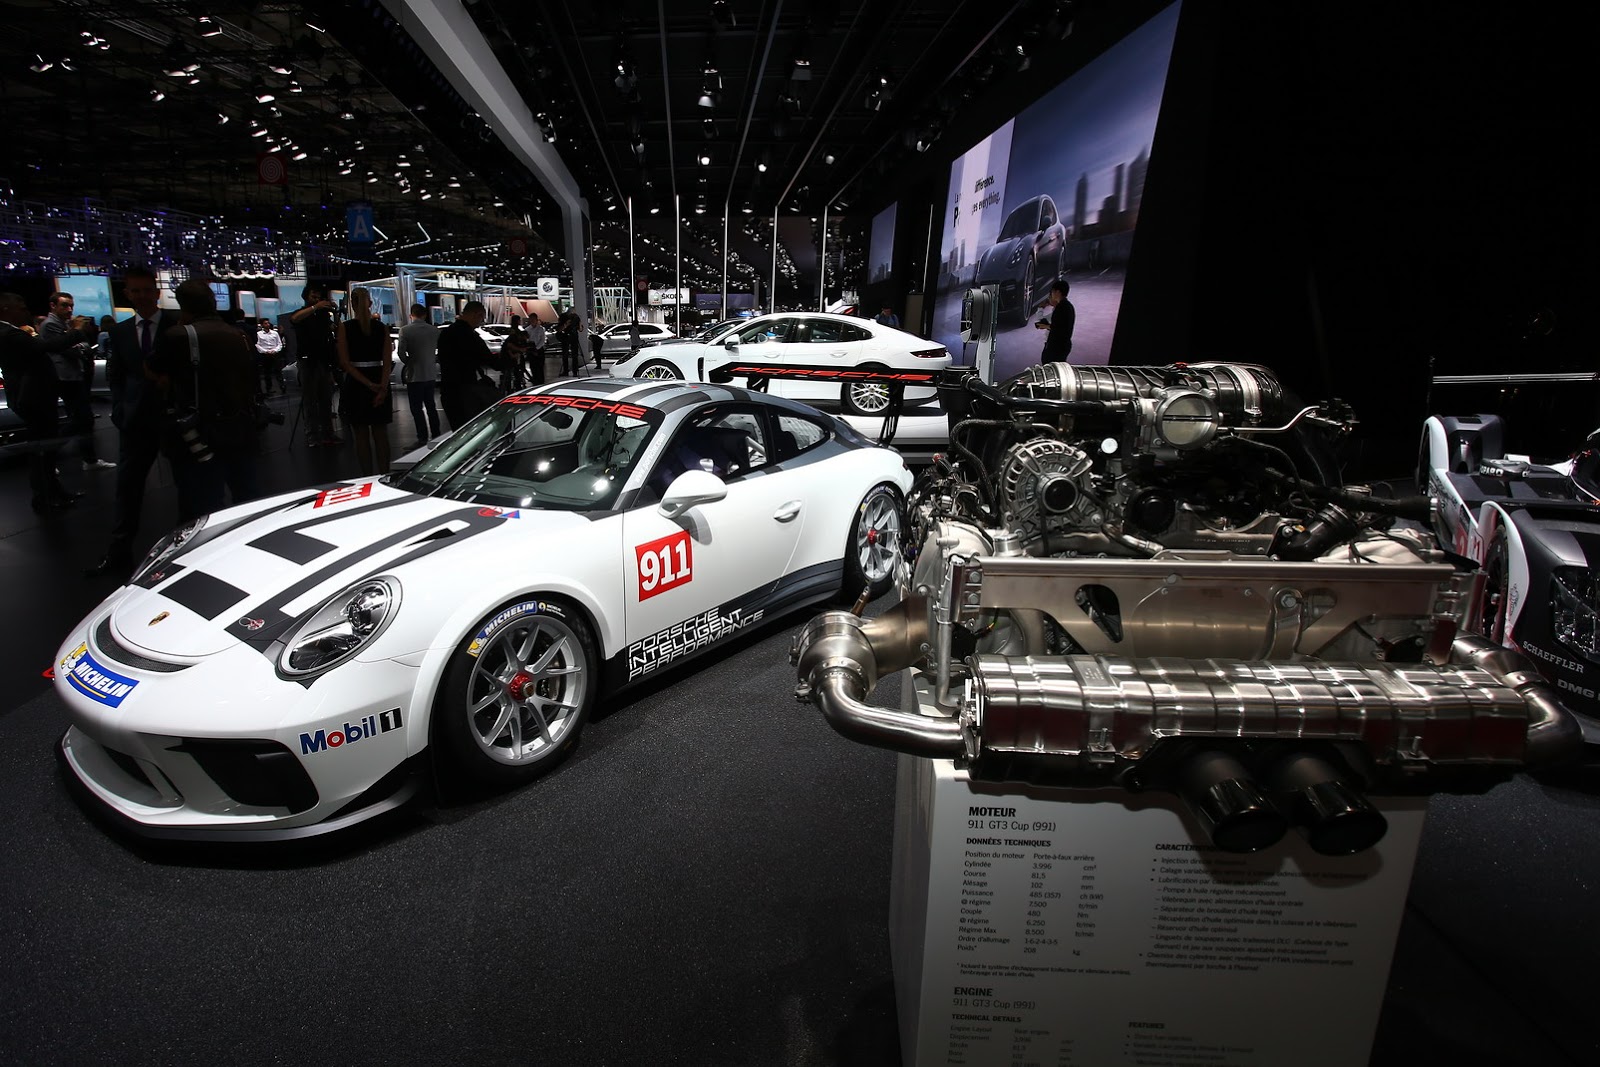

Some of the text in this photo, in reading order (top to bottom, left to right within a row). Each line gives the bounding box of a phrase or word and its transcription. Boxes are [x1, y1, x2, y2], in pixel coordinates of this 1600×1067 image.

[978, 191, 1001, 210] everything.
[353, 214, 369, 239] A
[730, 366, 933, 381] PORSCHE
[498, 395, 648, 419] PORSCHE
[321, 484, 365, 507] 911
[640, 539, 691, 591] 911
[483, 602, 535, 636] MICHELIN
[629, 607, 720, 658] PORSCHE
[629, 608, 742, 670] INTELLIGENT
[629, 609, 764, 682] PERFORMANCE
[1522, 640, 1584, 674] SCHAEFFLER
[74, 661, 134, 698] MICHELIN
[1557, 678, 1595, 699] DMG
[299, 716, 376, 755] Mobil
[968, 806, 1016, 817] MOTEUR
[968, 820, 1056, 832] 911 GT3 Cup (991)
[966, 837, 1051, 847] DONNÉES TECHNIQUES
[1033, 853, 1072, 861] Porte-à-faux
[963, 880, 987, 888] Alésage
[1160, 905, 1195, 913] Séparateur
[959, 926, 982, 934] Régime
[978, 936, 1010, 944] d'allumage
[954, 987, 993, 997] ENGINE
[953, 998, 1036, 1010] 911 GT3 Cup (991)
[952, 1013, 1021, 1023] TECHNICAL DETAILS
